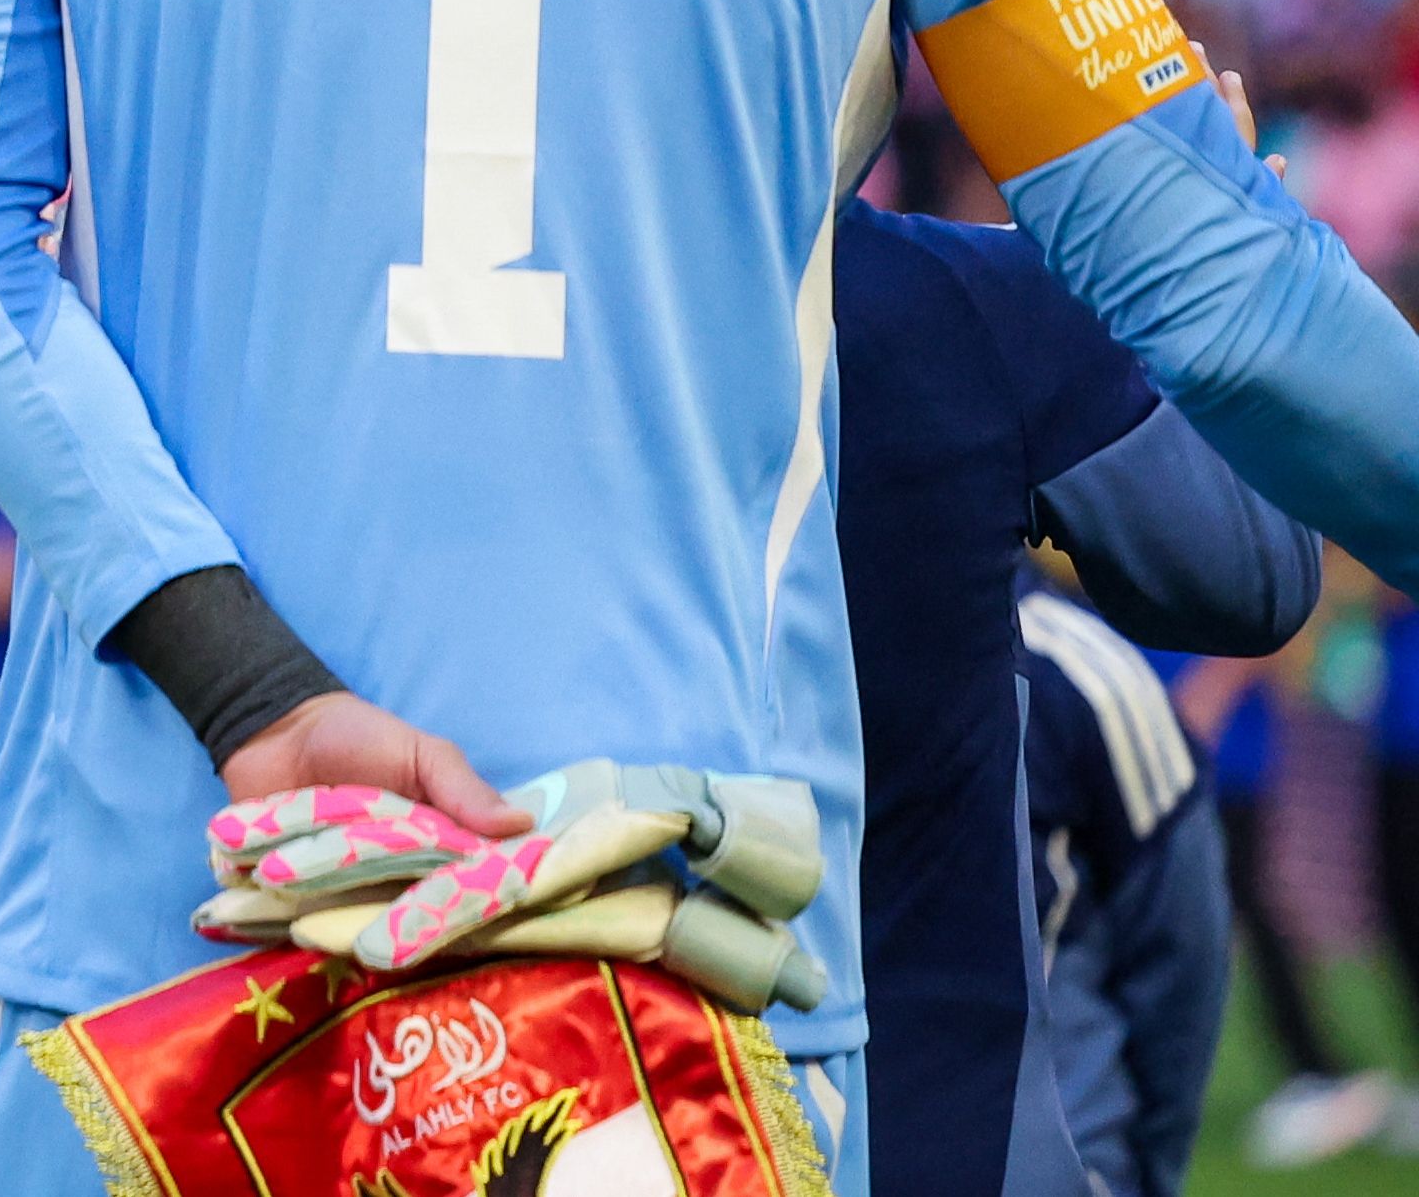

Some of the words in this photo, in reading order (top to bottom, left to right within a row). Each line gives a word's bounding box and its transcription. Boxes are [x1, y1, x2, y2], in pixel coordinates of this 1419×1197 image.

[1075, 46, 1133, 90] the
[1143, 58, 1184, 89] FIFA
[382, 1125, 412, 1159] AL
[414, 1094, 475, 1141] AHLY
[482, 1081, 524, 1116] FC
